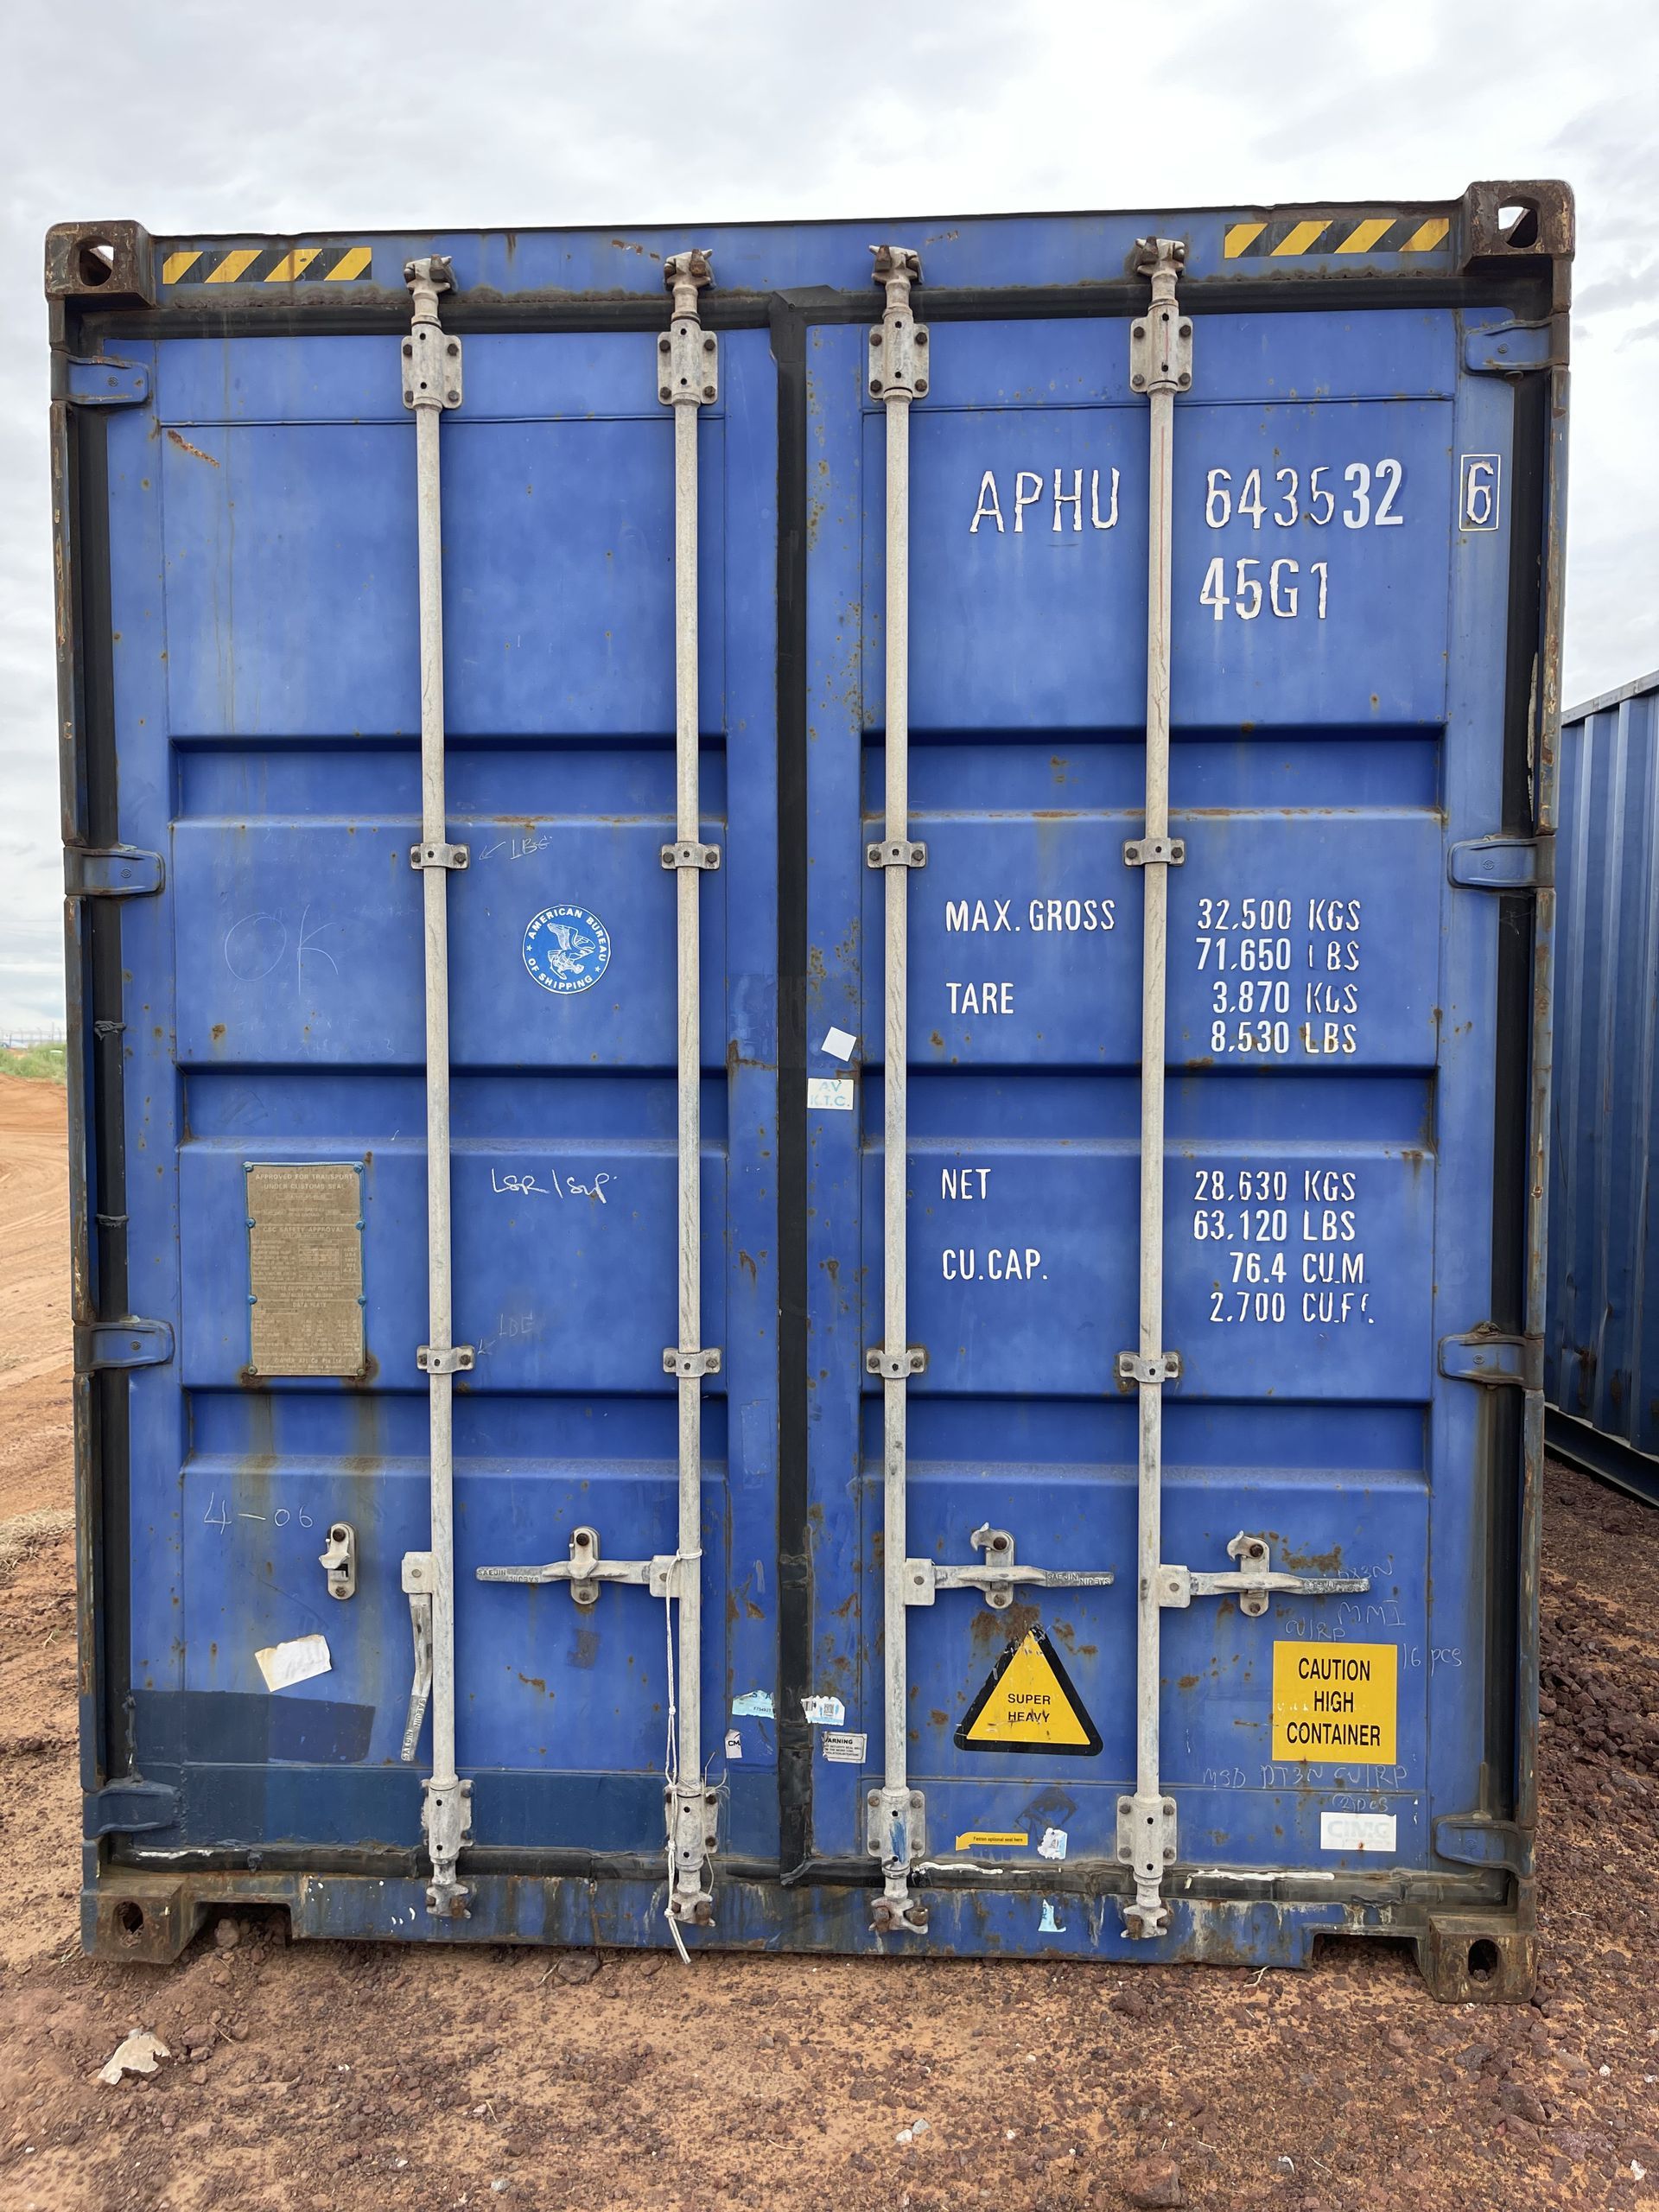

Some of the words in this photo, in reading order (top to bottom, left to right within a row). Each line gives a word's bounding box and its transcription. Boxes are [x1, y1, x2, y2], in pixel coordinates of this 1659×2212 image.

[969, 467, 1120, 533] APHU
[1205, 458, 1403, 530] 643532
[1466, 461, 1494, 524] 6
[1199, 557, 1328, 620] 45G1
[945, 899, 1020, 931] MAX.
[1029, 899, 1116, 931] GROSS
[1308, 899, 1361, 931] KGS
[225, 903, 339, 996] OK
[528, 907, 583, 940] AMERICAN
[585, 916, 607, 963] BUREAU
[527, 957, 540, 973] OF
[537, 972, 594, 991] SHIPPING
[945, 982, 1014, 1014] TARE
[1306, 982, 1358, 1014] KGS
[1305, 1021, 1357, 1053] LBS
[942, 1168, 991, 1199] NET
[1305, 1170, 1356, 1202] KGS
[1303, 1210, 1356, 1241] LBS
[943, 1249, 1048, 1281] CU.CAP.
[1230, 1251, 1287, 1283] 76.4
[1299, 1657, 1370, 1681] CAUTION
[1007, 1694, 1051, 1705] SUPER
[1314, 1690, 1354, 1713] HIGH
[1007, 1712, 1051, 1723] HEAVY
[1287, 1721, 1381, 1746] CONTAINER
